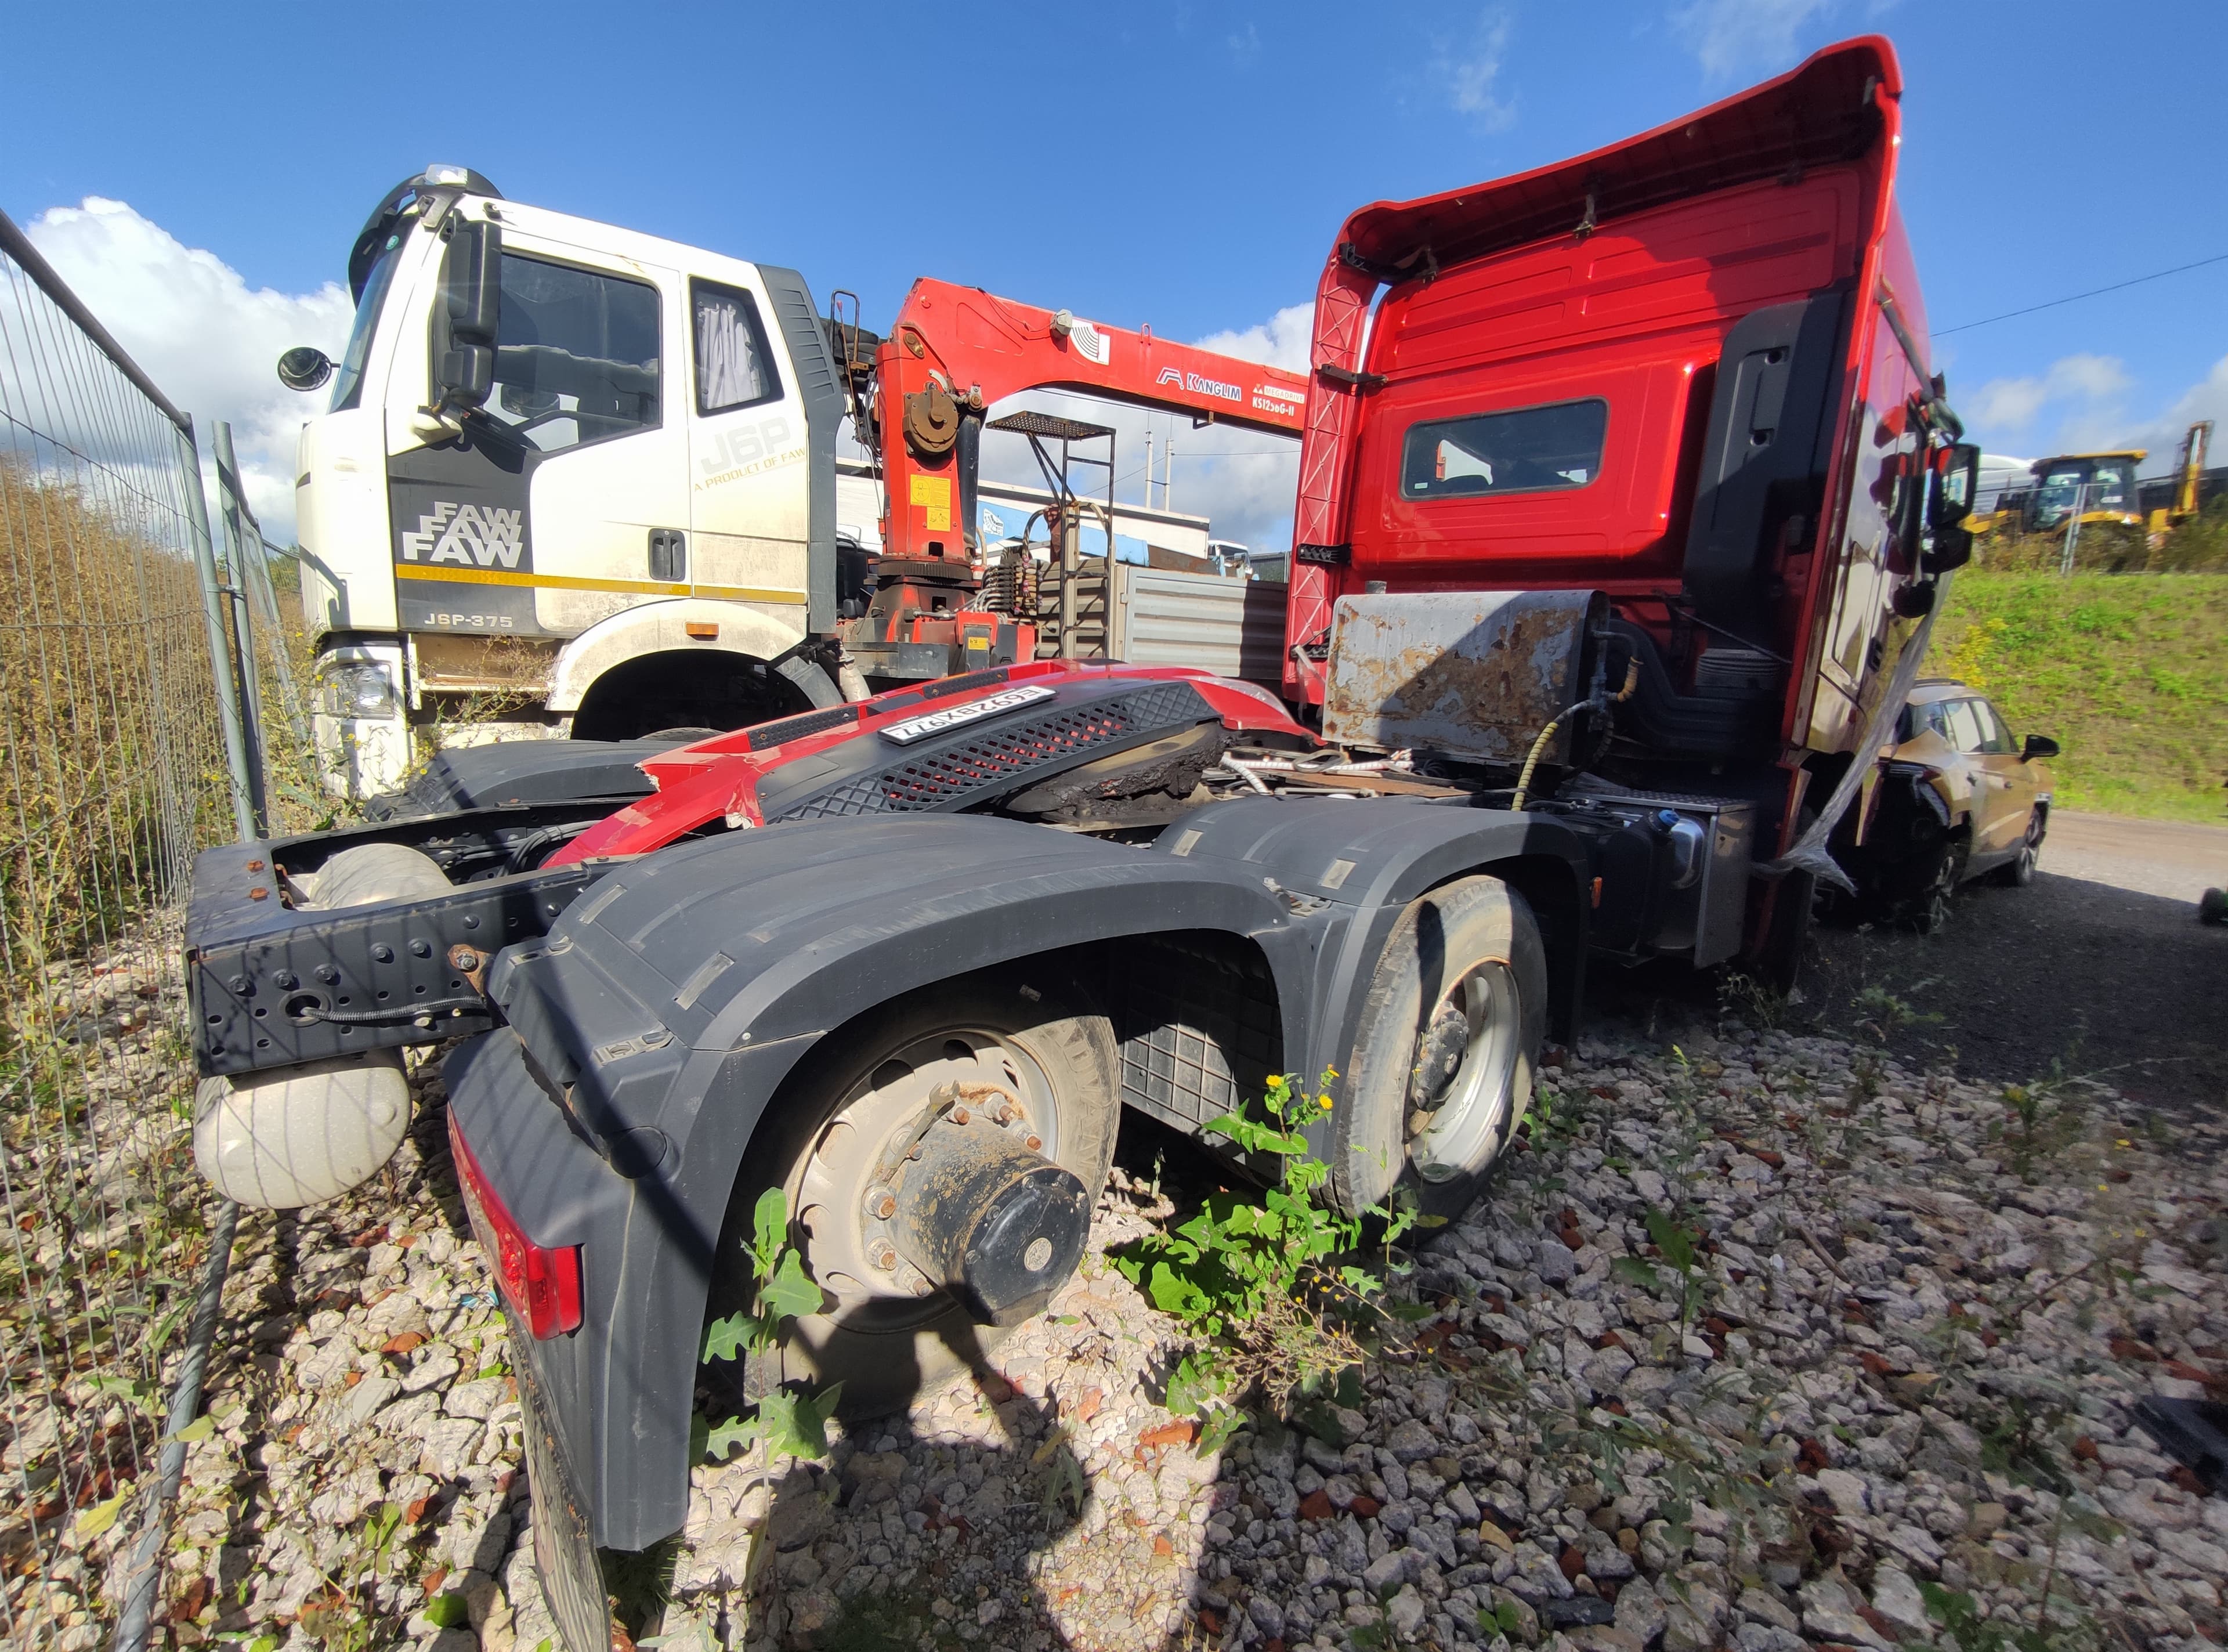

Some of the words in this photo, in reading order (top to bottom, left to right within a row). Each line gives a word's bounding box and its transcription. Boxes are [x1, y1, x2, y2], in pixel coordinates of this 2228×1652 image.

[1187, 373, 1242, 402] KANGLIM
[1265, 386, 1304, 403] MEGADRIVE
[700, 416, 791, 475] J6P
[694, 483, 703, 493] A
[705, 463, 759, 489] PRODUCT
[764, 456, 779, 468] OF
[781, 447, 806, 462] FAW
[419, 515, 522, 547] FAW
[434, 501, 521, 529] FAW
[402, 531, 523, 569] FAW
[424, 613, 513, 628] J6P-375
[938, 689, 1039, 721] E692BX
[901, 720, 946, 736] 977
[1043, 1018, 1104, 1185] ADVAN
